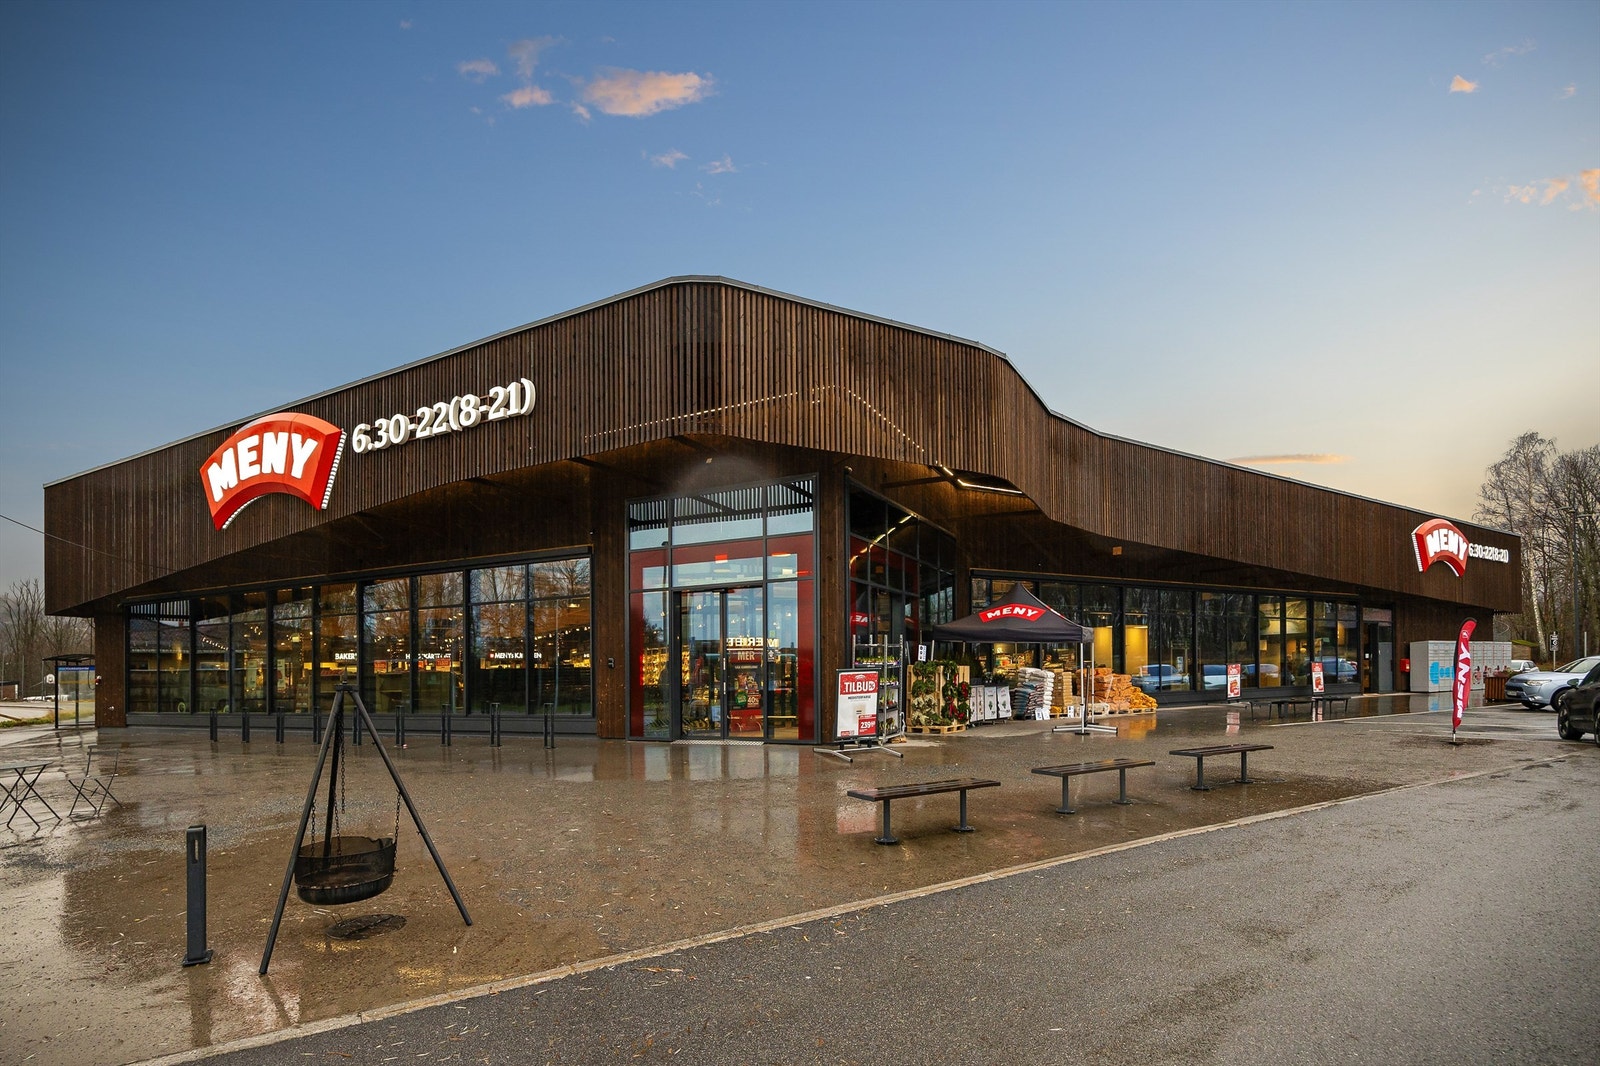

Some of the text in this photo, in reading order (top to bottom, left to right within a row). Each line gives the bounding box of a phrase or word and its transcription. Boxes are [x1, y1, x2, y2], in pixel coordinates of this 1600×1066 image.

[352, 378, 536, 454] 6.30-22(8-21)
[207, 431, 319, 502] MENY
[1426, 528, 1468, 561] MENY
[986, 605, 1039, 618] MENY
[737, 651, 755, 661] MER
[844, 681, 876, 693] TILBUD
[1457, 642, 1470, 718] MENY
